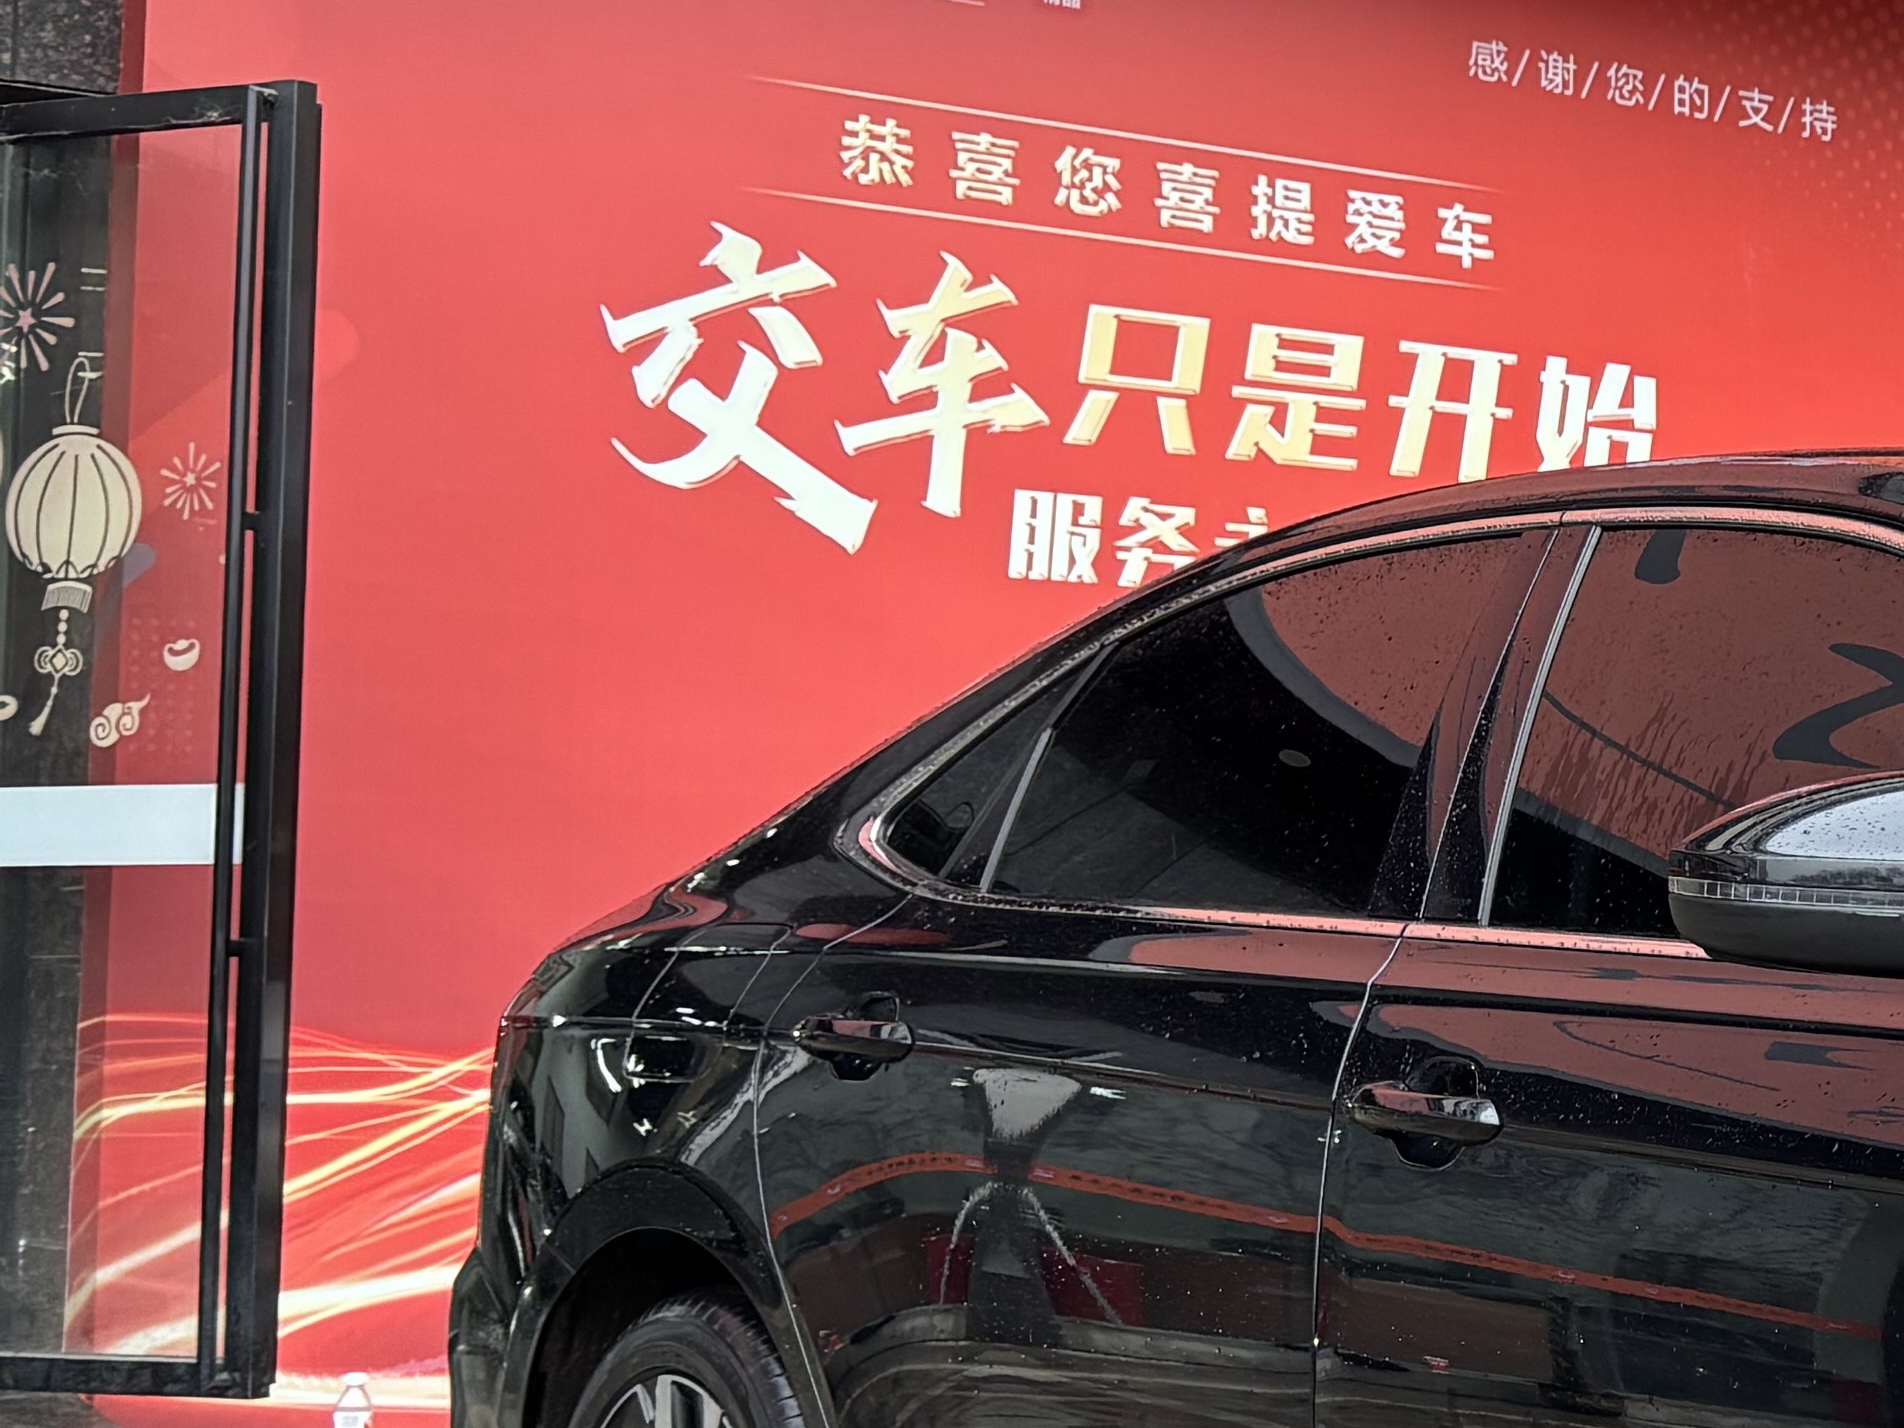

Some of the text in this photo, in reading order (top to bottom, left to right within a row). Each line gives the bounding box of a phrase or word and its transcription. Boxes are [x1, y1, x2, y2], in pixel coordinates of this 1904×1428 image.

[838, 113, 1495, 269] 恭喜您喜提爱车
[601, 221, 1659, 555] 交车只是开始
